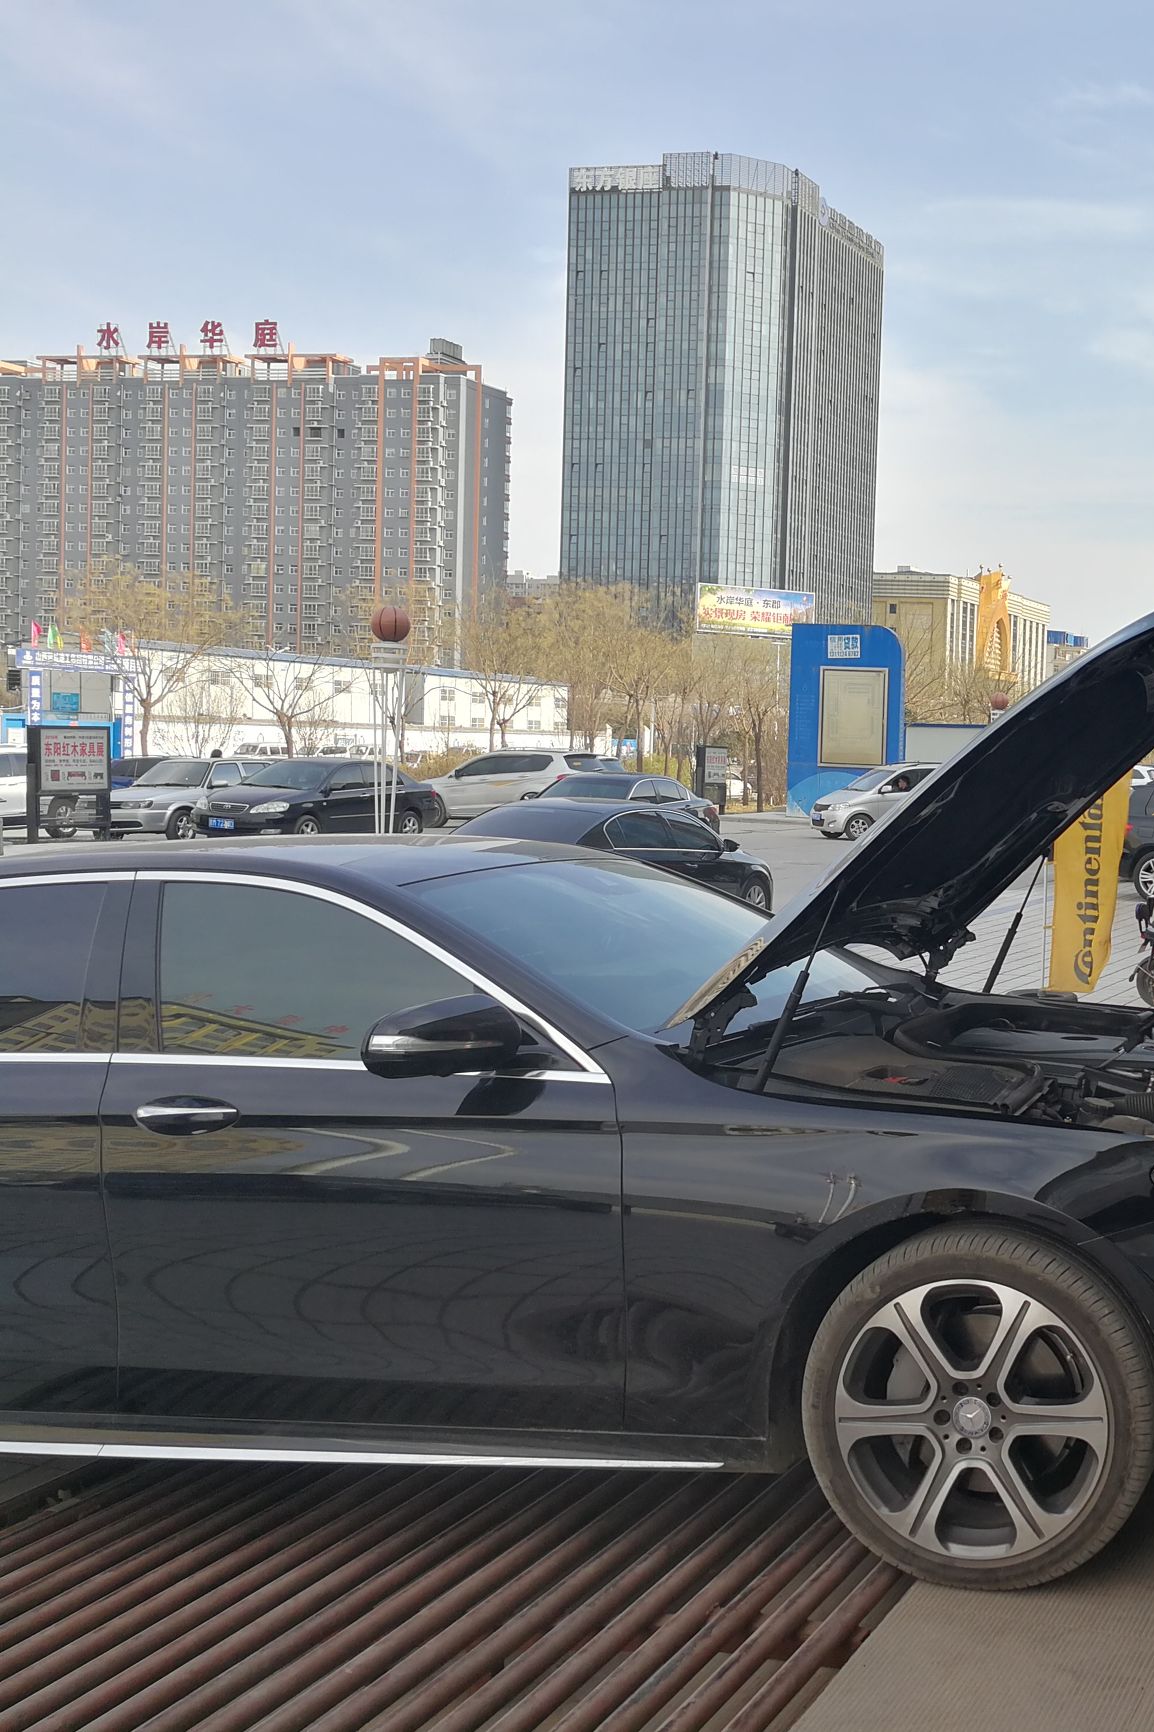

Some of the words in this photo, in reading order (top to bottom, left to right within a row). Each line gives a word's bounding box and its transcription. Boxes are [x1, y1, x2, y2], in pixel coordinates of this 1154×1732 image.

[97, 319, 278, 350] 水岸华庭
[44, 741, 104, 757] 东阳红木家具展
[1073, 795, 1104, 985] Continenta
